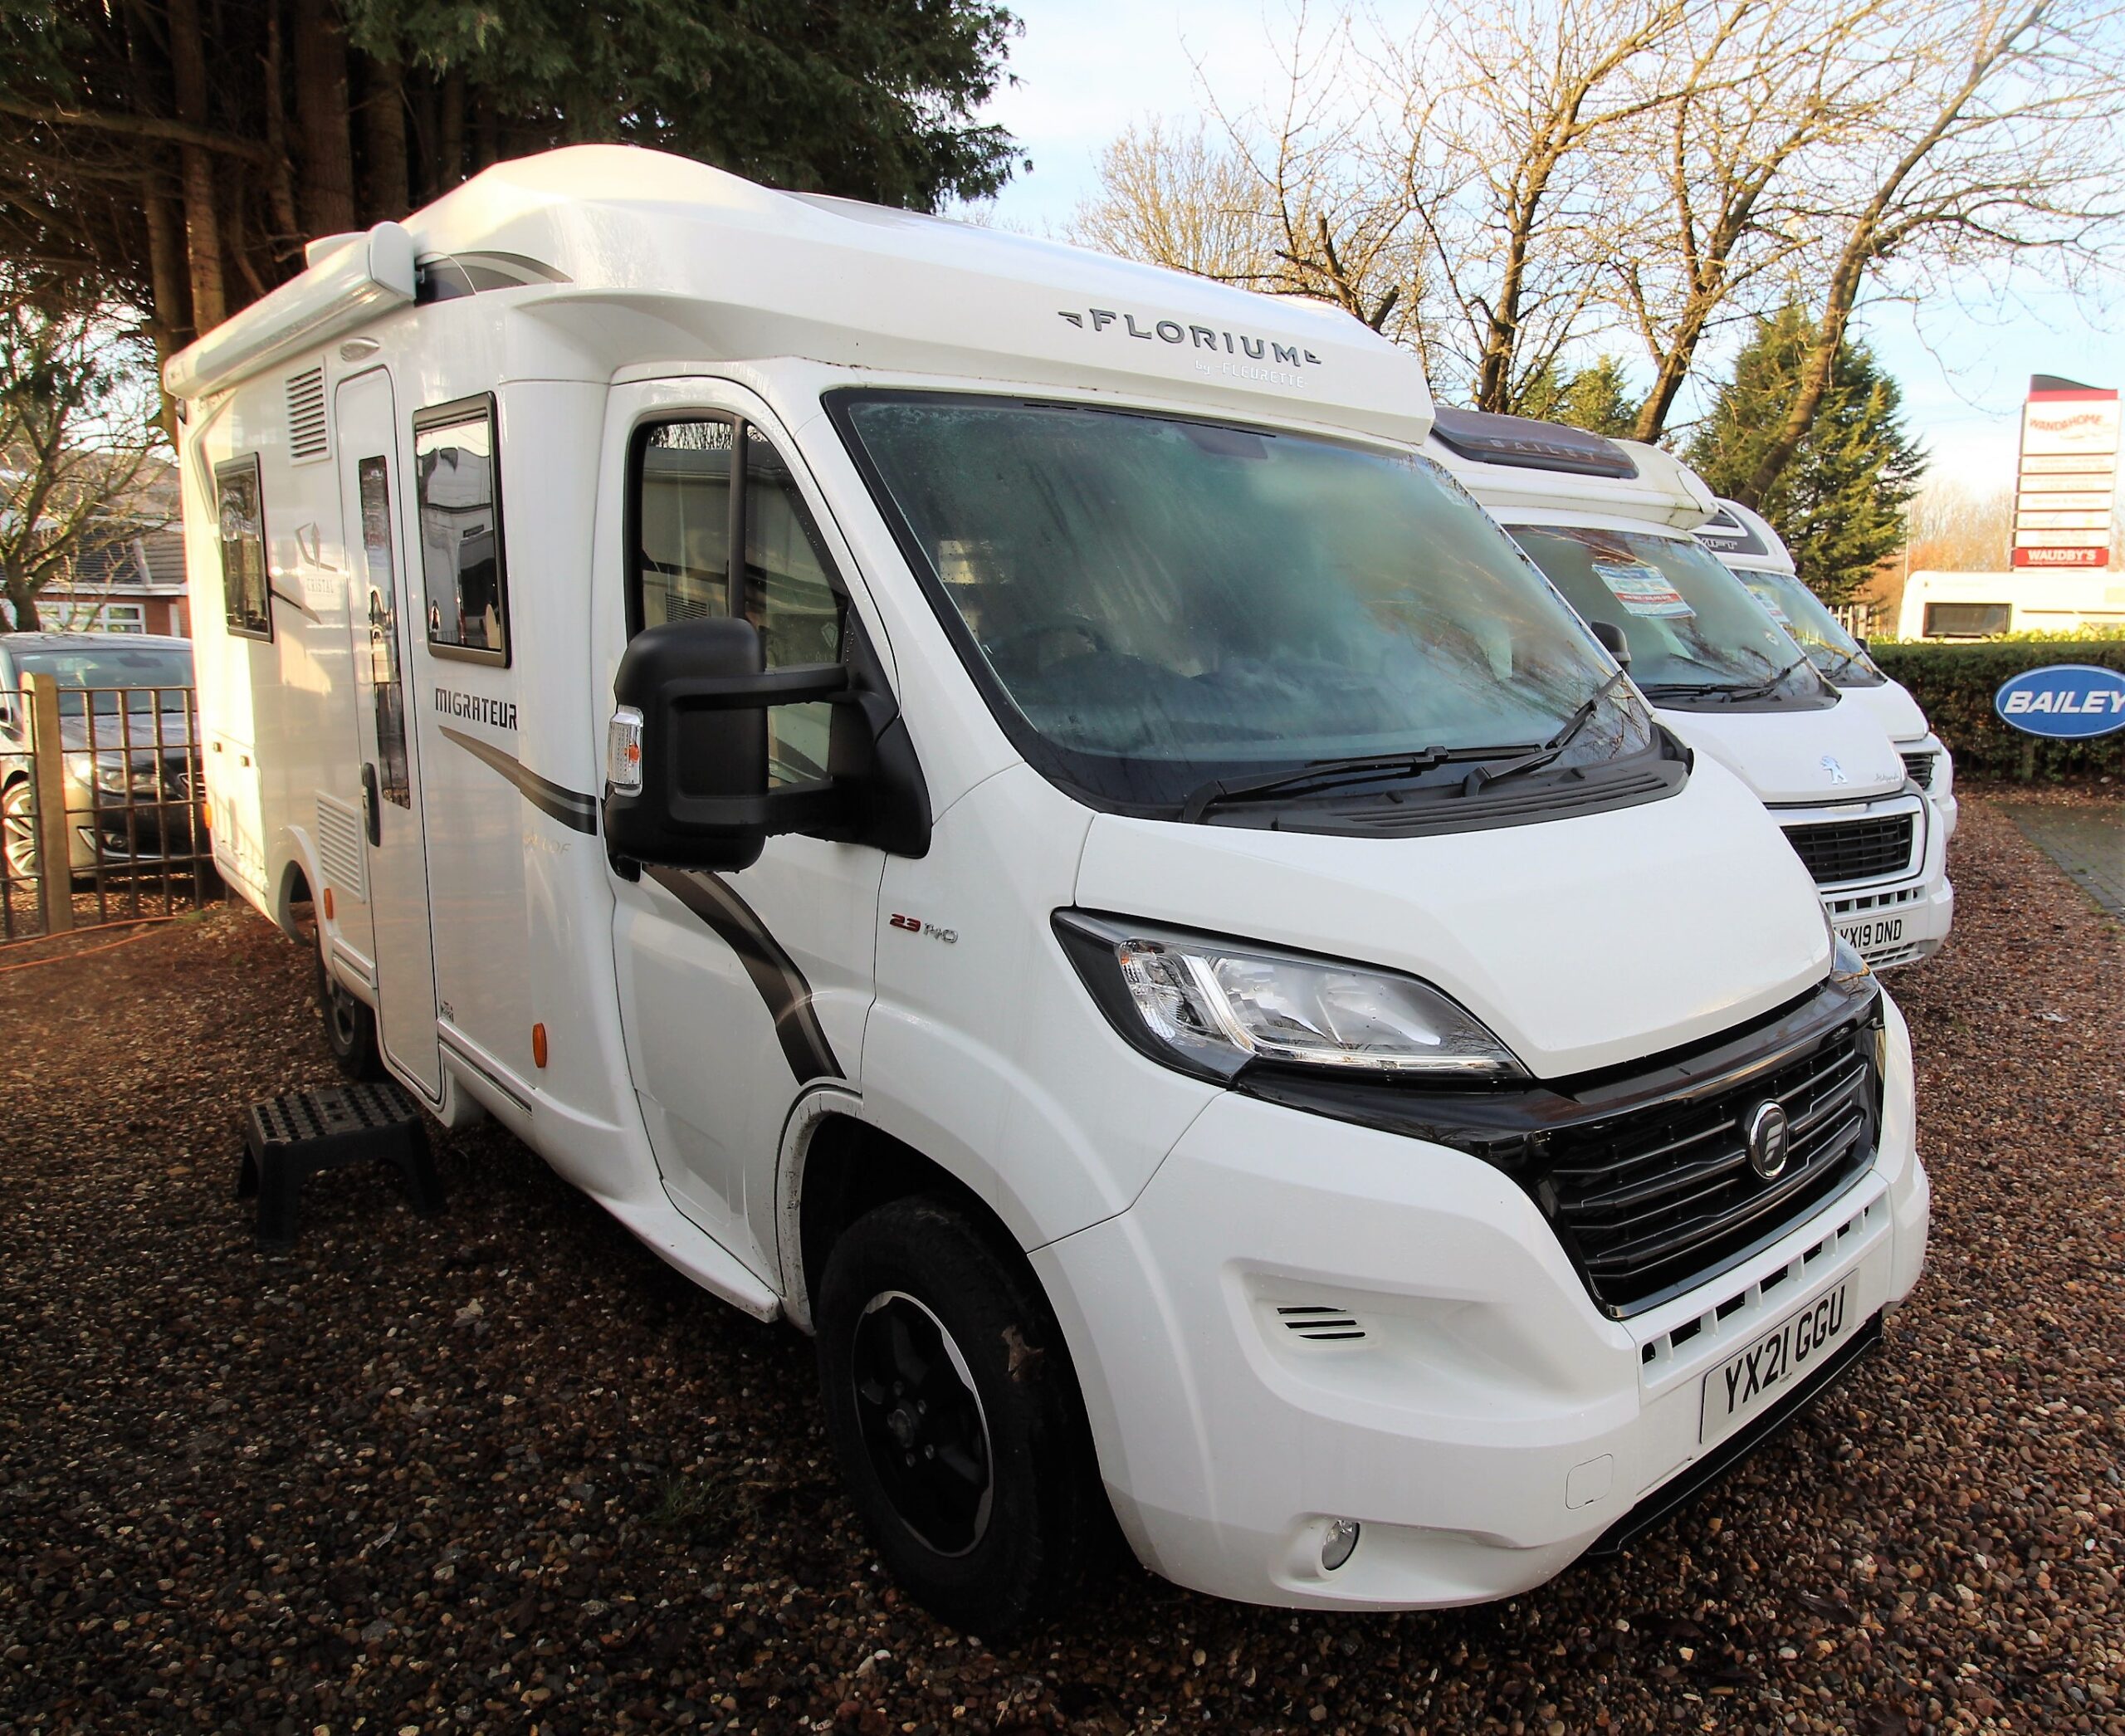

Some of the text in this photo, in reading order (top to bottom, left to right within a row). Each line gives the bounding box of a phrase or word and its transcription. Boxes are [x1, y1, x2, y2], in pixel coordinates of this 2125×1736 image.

[1088, 307, 1302, 367] FLORIUM
[1194, 359, 1306, 389] by FLEURETTE
[1489, 438, 1595, 462] BAILEY
[2027, 550, 2097, 561] WAUDBY'S
[435, 687, 518, 731] MIGRATEUR
[2003, 691, 2125, 714] BAILEY
[1874, 918, 1903, 944] DND
[1725, 1284, 1845, 1415] YX21 GGU
